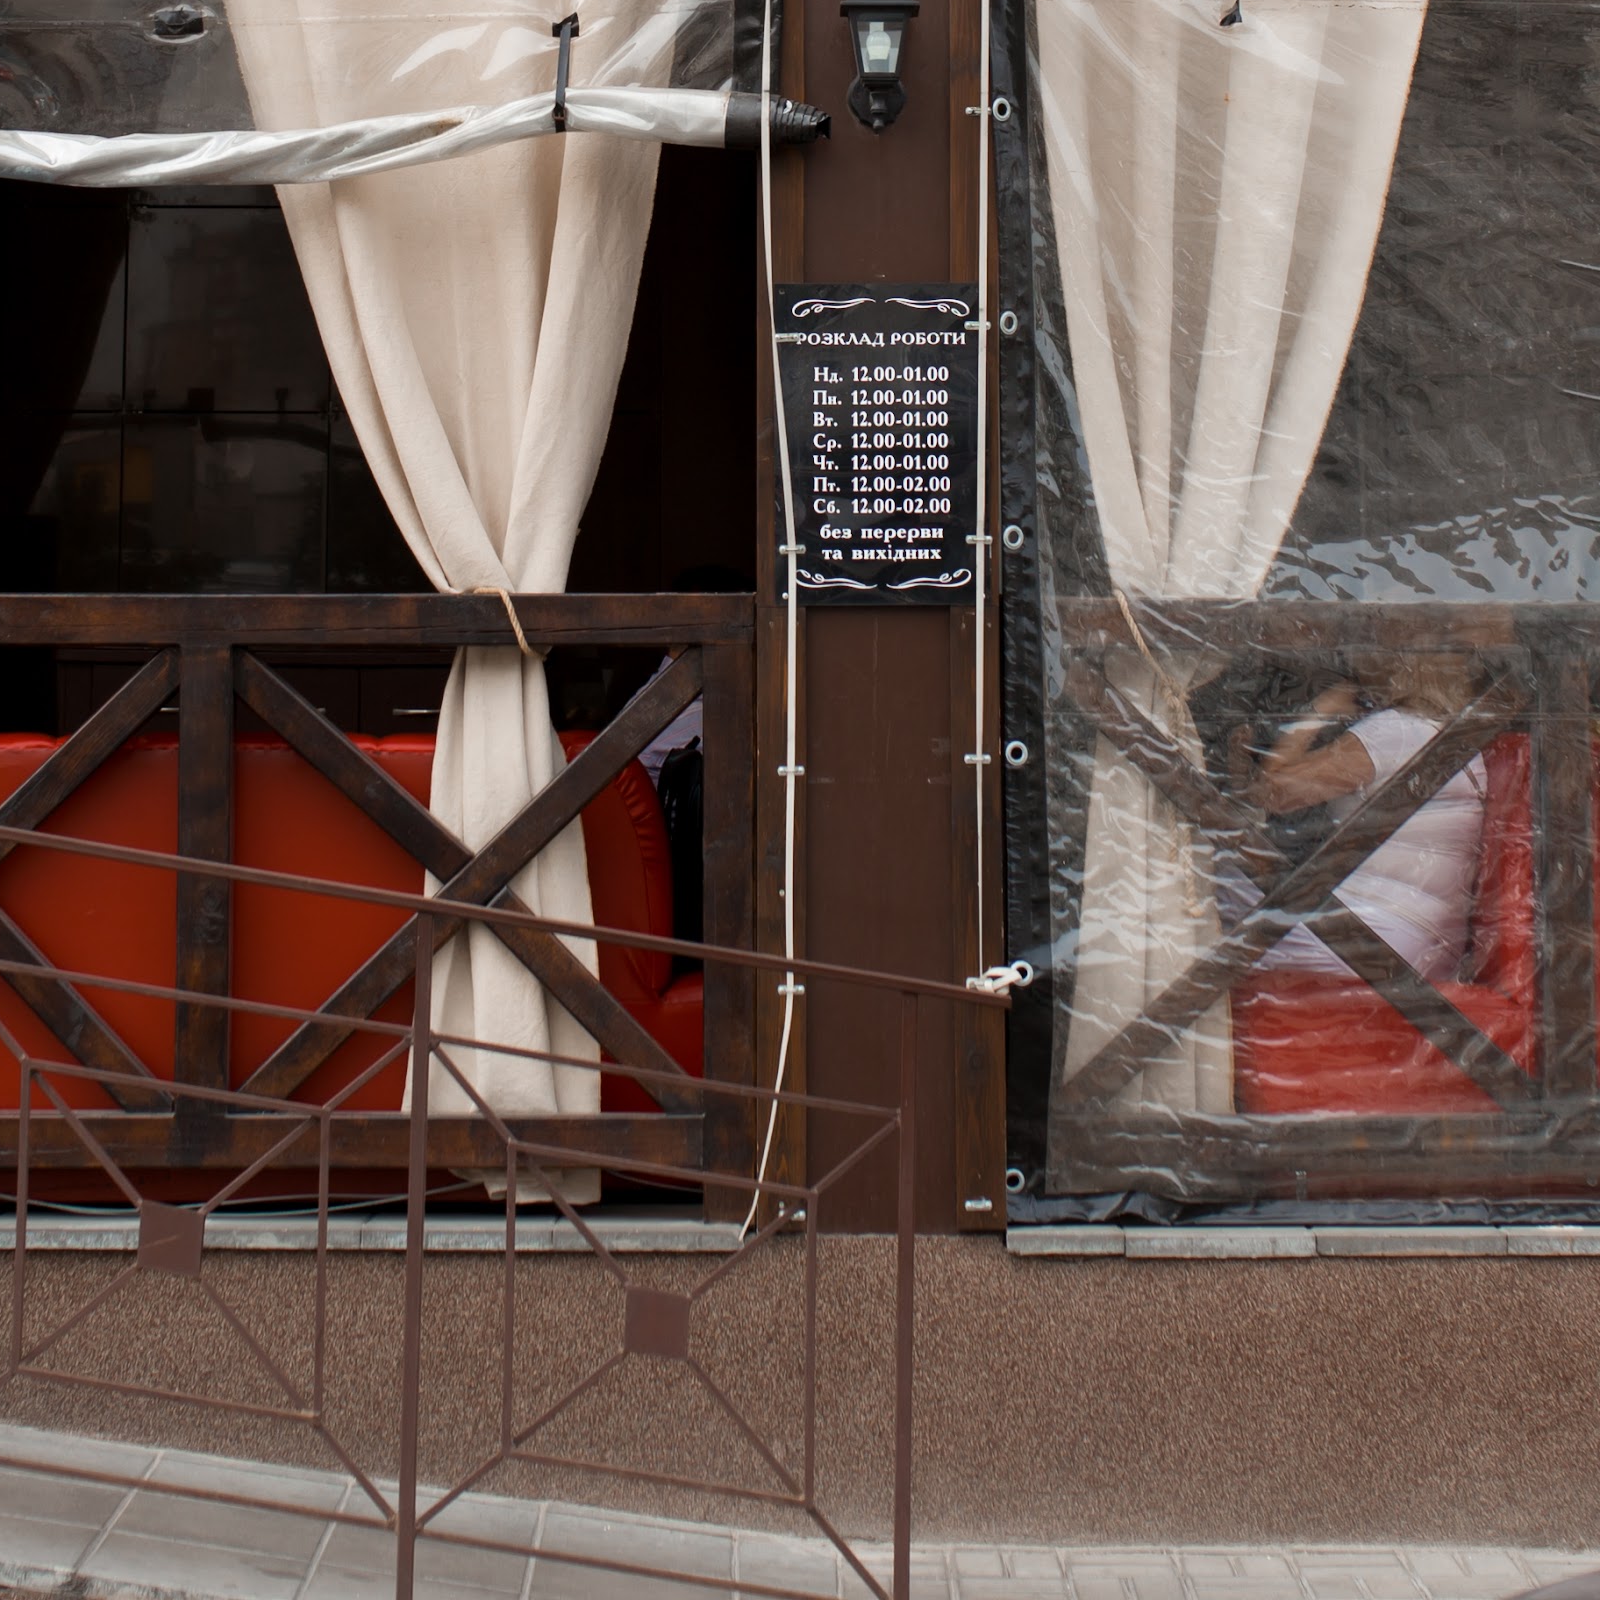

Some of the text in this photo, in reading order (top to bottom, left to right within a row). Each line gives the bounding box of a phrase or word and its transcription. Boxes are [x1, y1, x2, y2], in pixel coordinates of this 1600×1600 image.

[796, 332, 965, 347] РОЗКЛАД РОБОТИ
[814, 366, 948, 383] Нд. 12.00-01.00
[813, 390, 948, 405] Пн. 12.00-01.00
[814, 411, 948, 427] Вт. 12.00-01.00
[813, 433, 948, 451] Ср. 12.00-01.00
[813, 455, 948, 470] Чт. 12.00-01.00
[814, 476, 950, 492] Пт. 12.00-02.00
[814, 498, 950, 513] Сб. 12.00-02.00
[820, 524, 943, 542] без перерви
[822, 545, 941, 562] та вихідних
